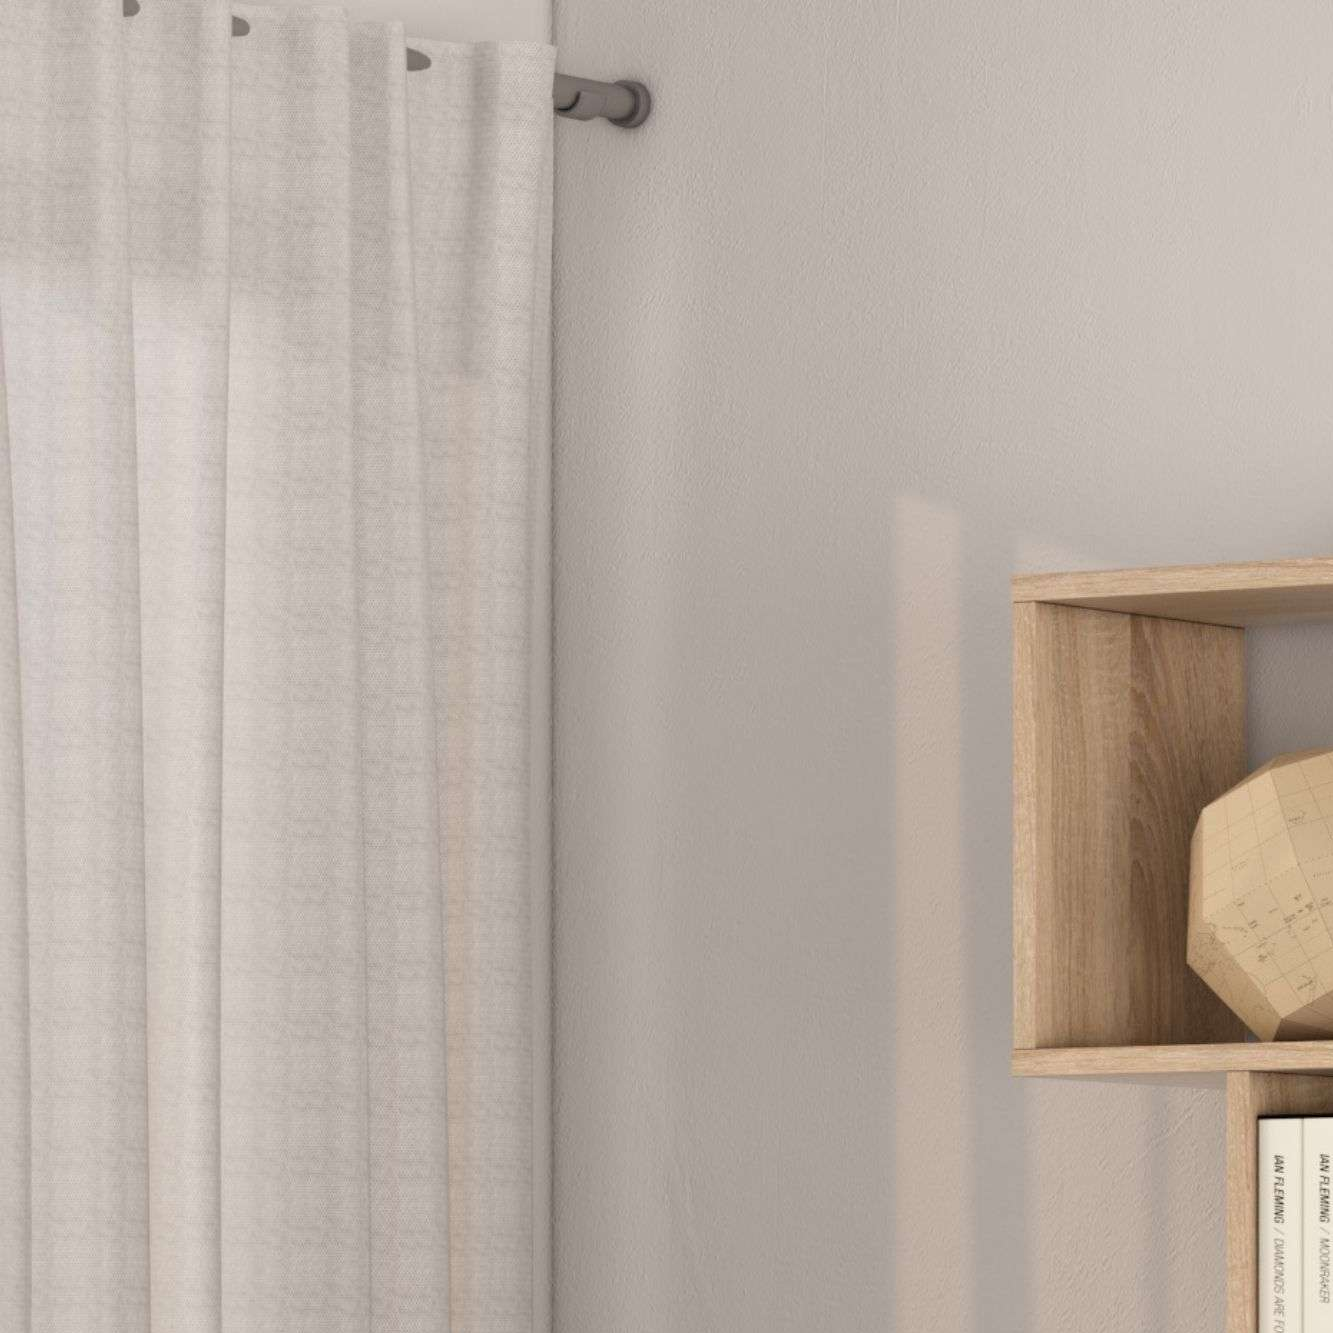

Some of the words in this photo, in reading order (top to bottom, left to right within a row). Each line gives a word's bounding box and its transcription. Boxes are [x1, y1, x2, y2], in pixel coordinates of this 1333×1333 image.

[1319, 1154, 1331, 1171] IAN
[1319, 1175, 1331, 1223] FLEMING
[1319, 1238, 1331, 1304] MOONRAKER
